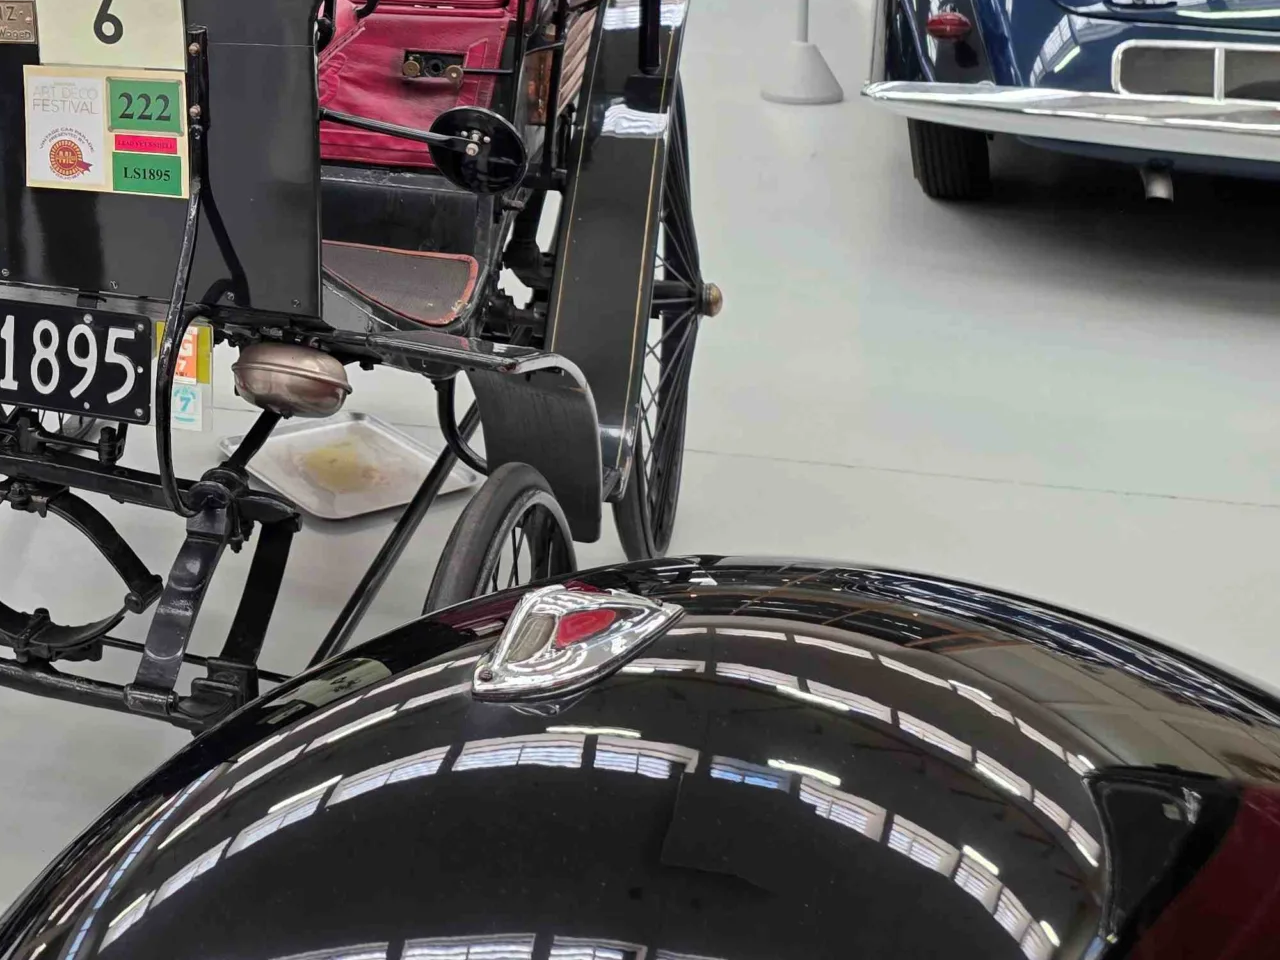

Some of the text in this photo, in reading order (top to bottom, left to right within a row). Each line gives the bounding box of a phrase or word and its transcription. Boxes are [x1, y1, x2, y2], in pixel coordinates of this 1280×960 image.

[61, 87, 99, 101] DECO
[32, 98, 100, 116] FESTIVAL
[118, 92, 172, 123] 222
[123, 167, 171, 181] LS1895
